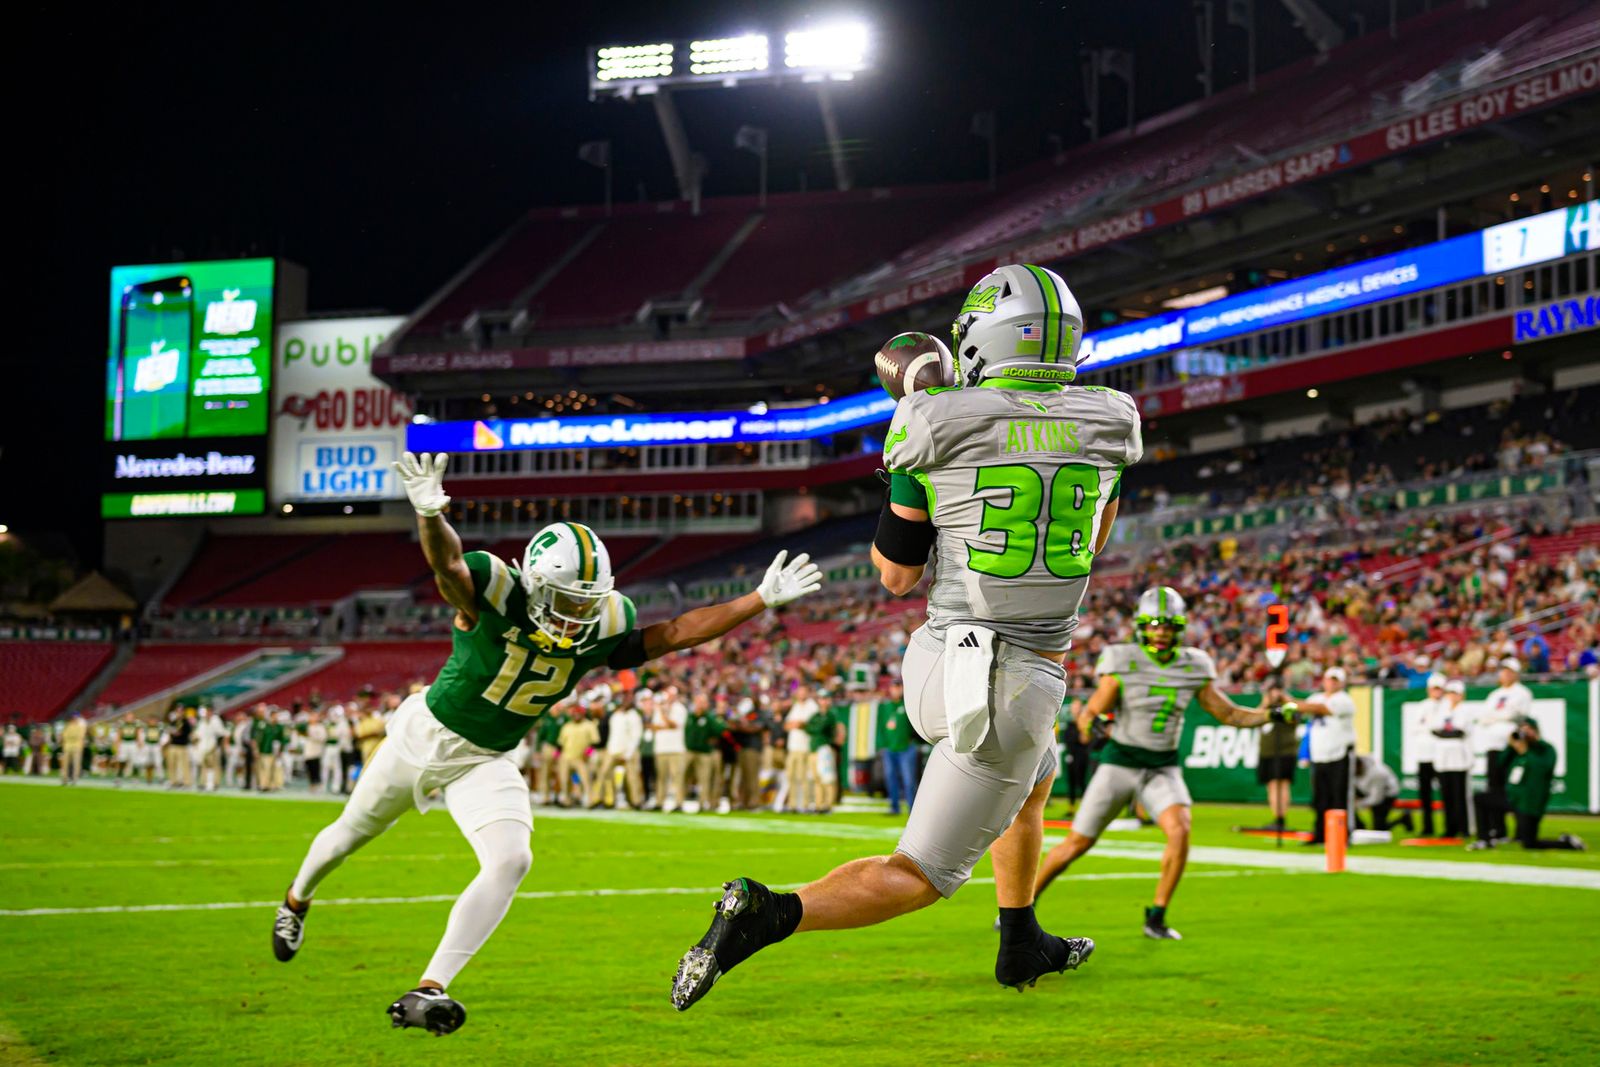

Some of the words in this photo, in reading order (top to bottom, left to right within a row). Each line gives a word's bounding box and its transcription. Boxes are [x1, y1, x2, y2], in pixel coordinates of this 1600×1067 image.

[1386, 122, 1411, 150] 63
[1415, 106, 1457, 140] LEE
[1461, 90, 1509, 125] ROY
[1514, 60, 1600, 109] SELMO
[1206, 164, 1282, 207] WARREN
[1284, 146, 1336, 183] SAPP
[1078, 210, 1143, 249] BROOKS
[1362, 263, 1419, 293] DEVICES
[1514, 295, 1600, 341] RAYM
[315, 390, 348, 431] GO
[510, 418, 733, 445] MicroLumen
[1004, 421, 1079, 454] ATKINS
[115, 451, 256, 479] Mercedes-Benz
[315, 445, 377, 468] BUD
[303, 469, 388, 494] LIGHT
[964, 463, 1101, 580] 38
[1266, 604, 1289, 651] 2
[481, 641, 575, 716] 12
[1147, 686, 1177, 734] 7
